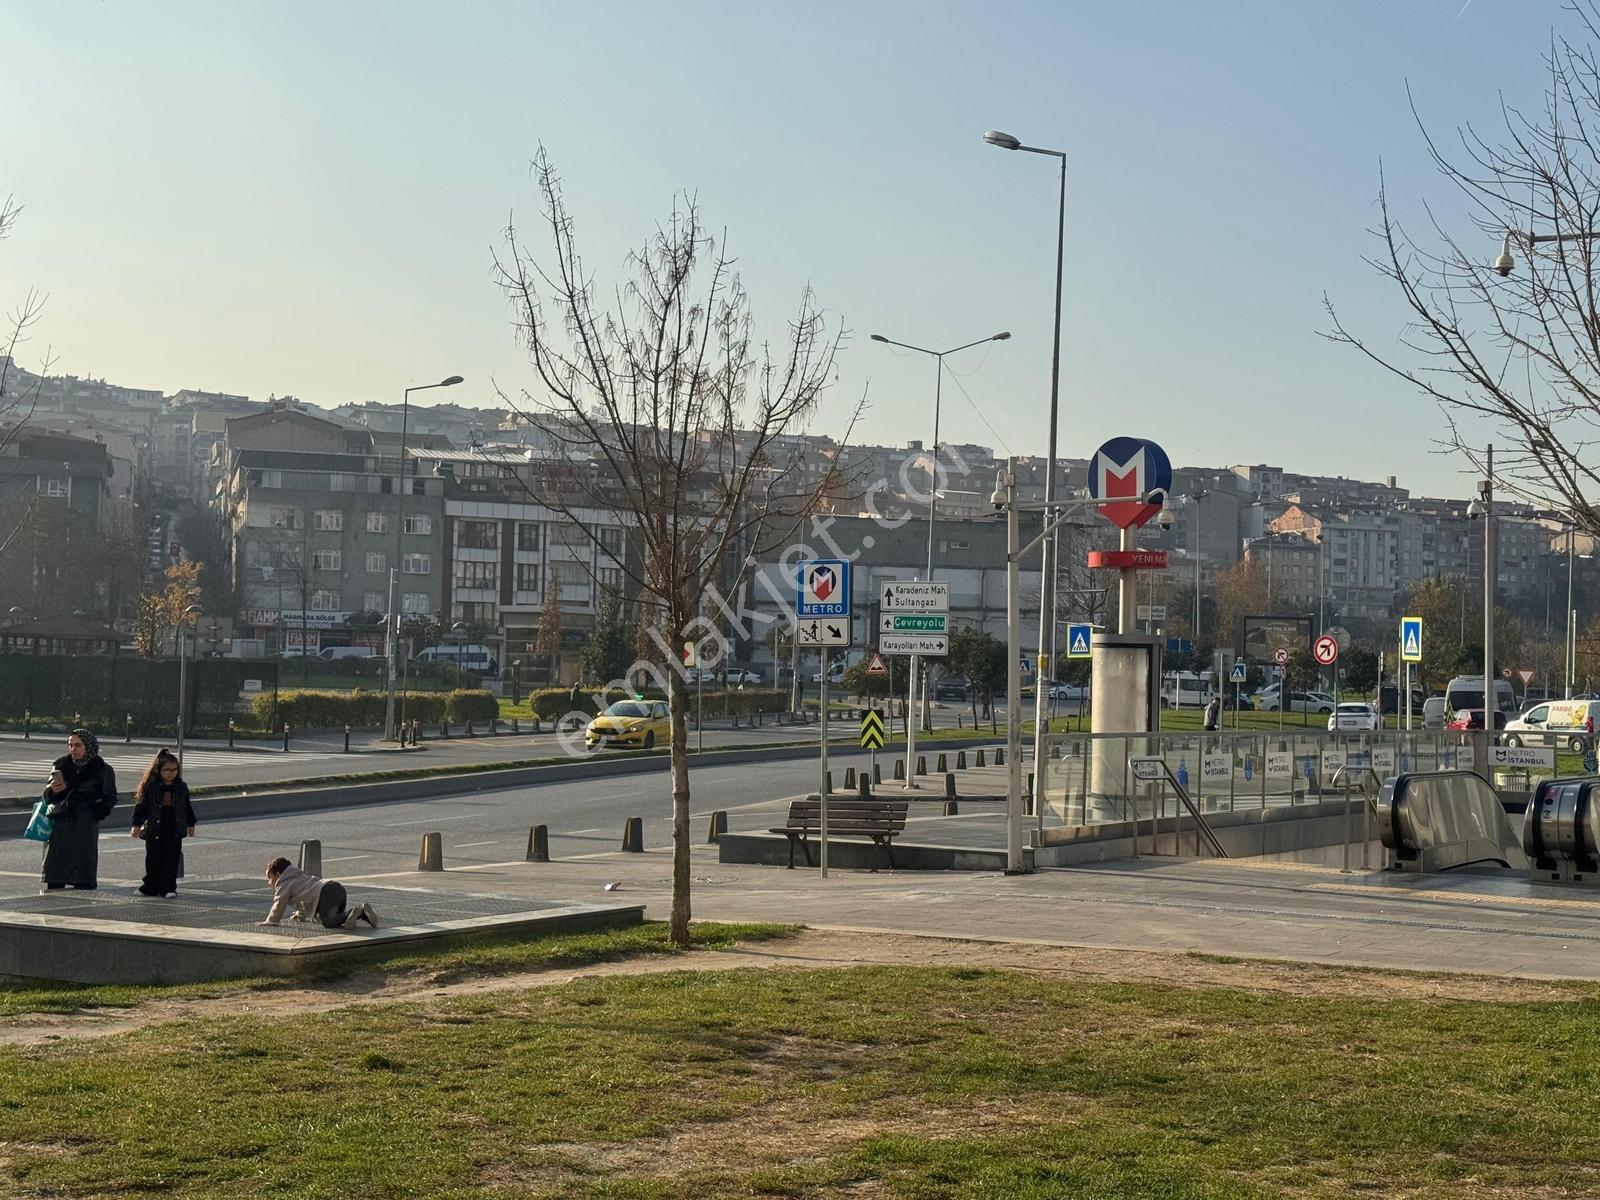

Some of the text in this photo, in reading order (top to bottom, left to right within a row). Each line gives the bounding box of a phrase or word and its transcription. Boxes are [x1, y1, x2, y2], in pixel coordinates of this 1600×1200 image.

[895, 585, 929, 595] Karadeniz
[895, 597, 937, 608] Sultangazi
[803, 605, 843, 614] METRO
[894, 617, 945, 629] Çevreyolu
